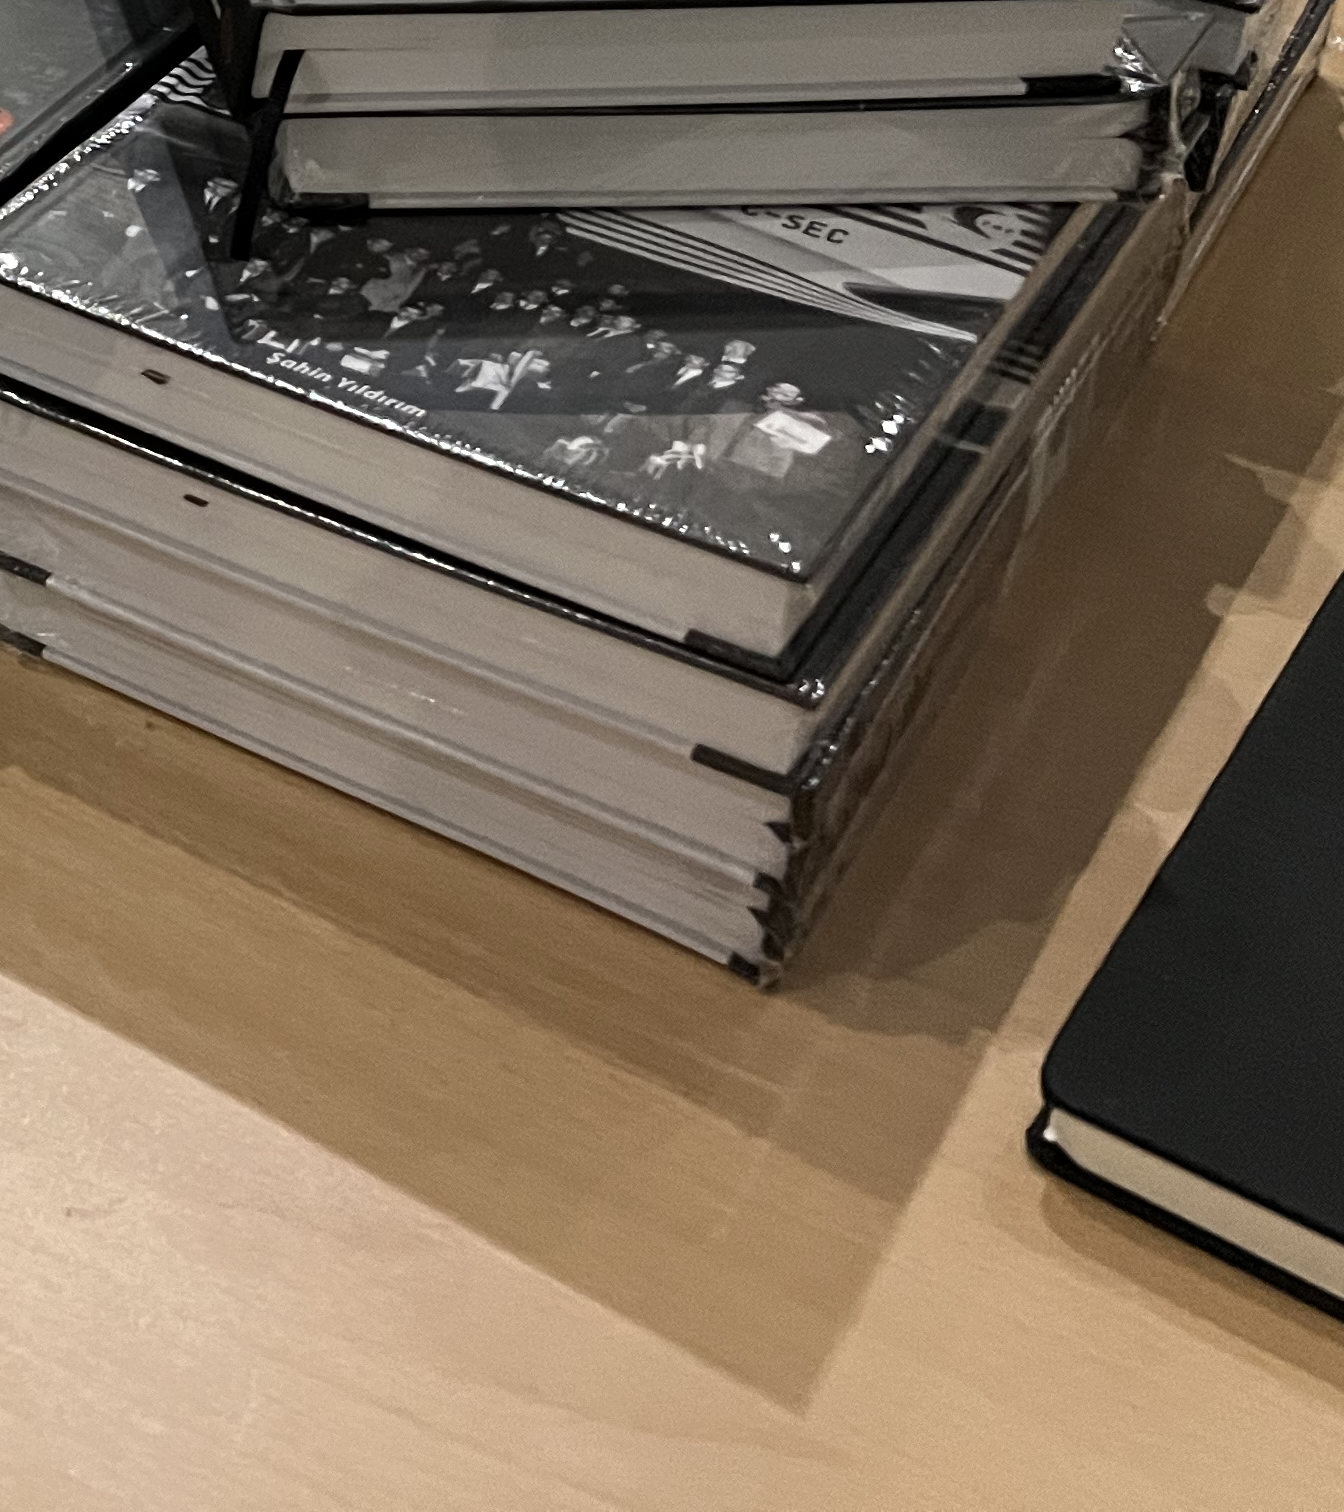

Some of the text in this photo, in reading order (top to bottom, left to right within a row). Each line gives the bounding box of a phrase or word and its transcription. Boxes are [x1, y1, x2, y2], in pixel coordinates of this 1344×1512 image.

[740, 202, 851, 246] C-SEC
[265, 347, 428, 419] Şahin Yıldırım
